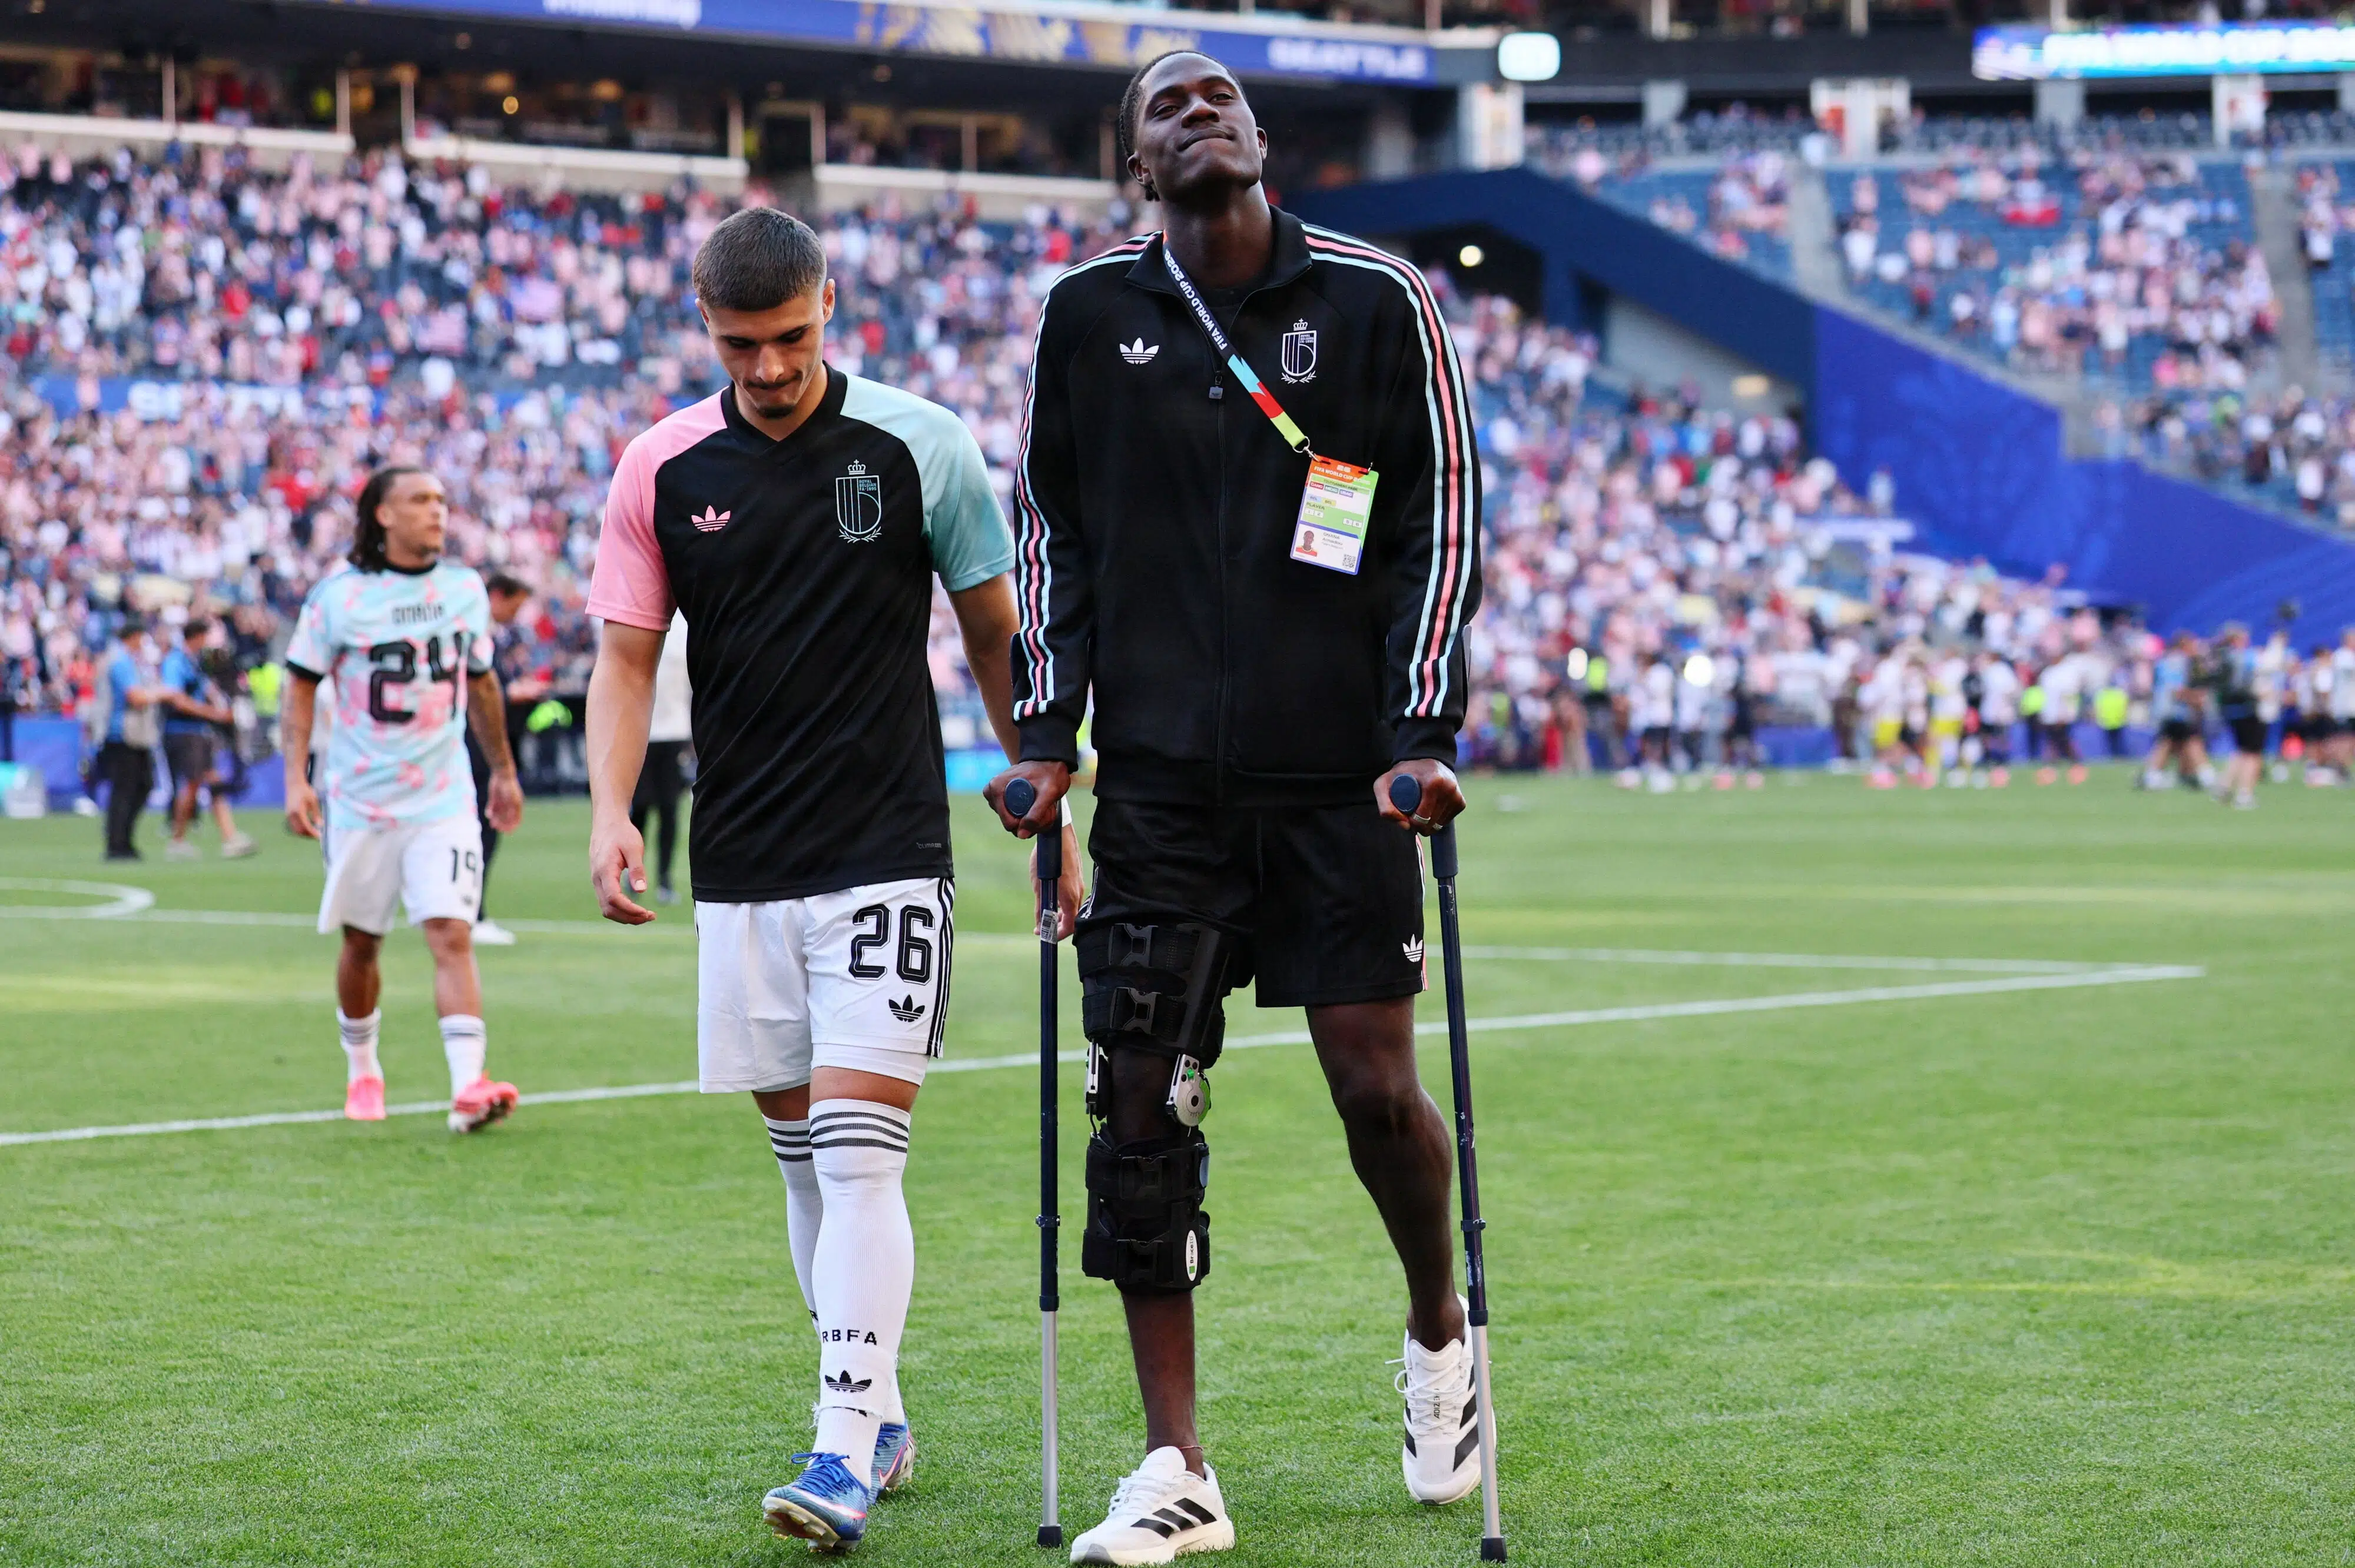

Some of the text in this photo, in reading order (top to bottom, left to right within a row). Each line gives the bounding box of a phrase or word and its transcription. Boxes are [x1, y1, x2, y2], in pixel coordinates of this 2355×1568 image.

[1165, 248, 1228, 350] FIFA WORLD CUP 2026
[1325, 469, 1343, 478] WORLD
[369, 632, 463, 725] 24
[451, 847, 477, 886] 19
[848, 903, 936, 986] 26
[822, 1329, 877, 1346] RBFA
